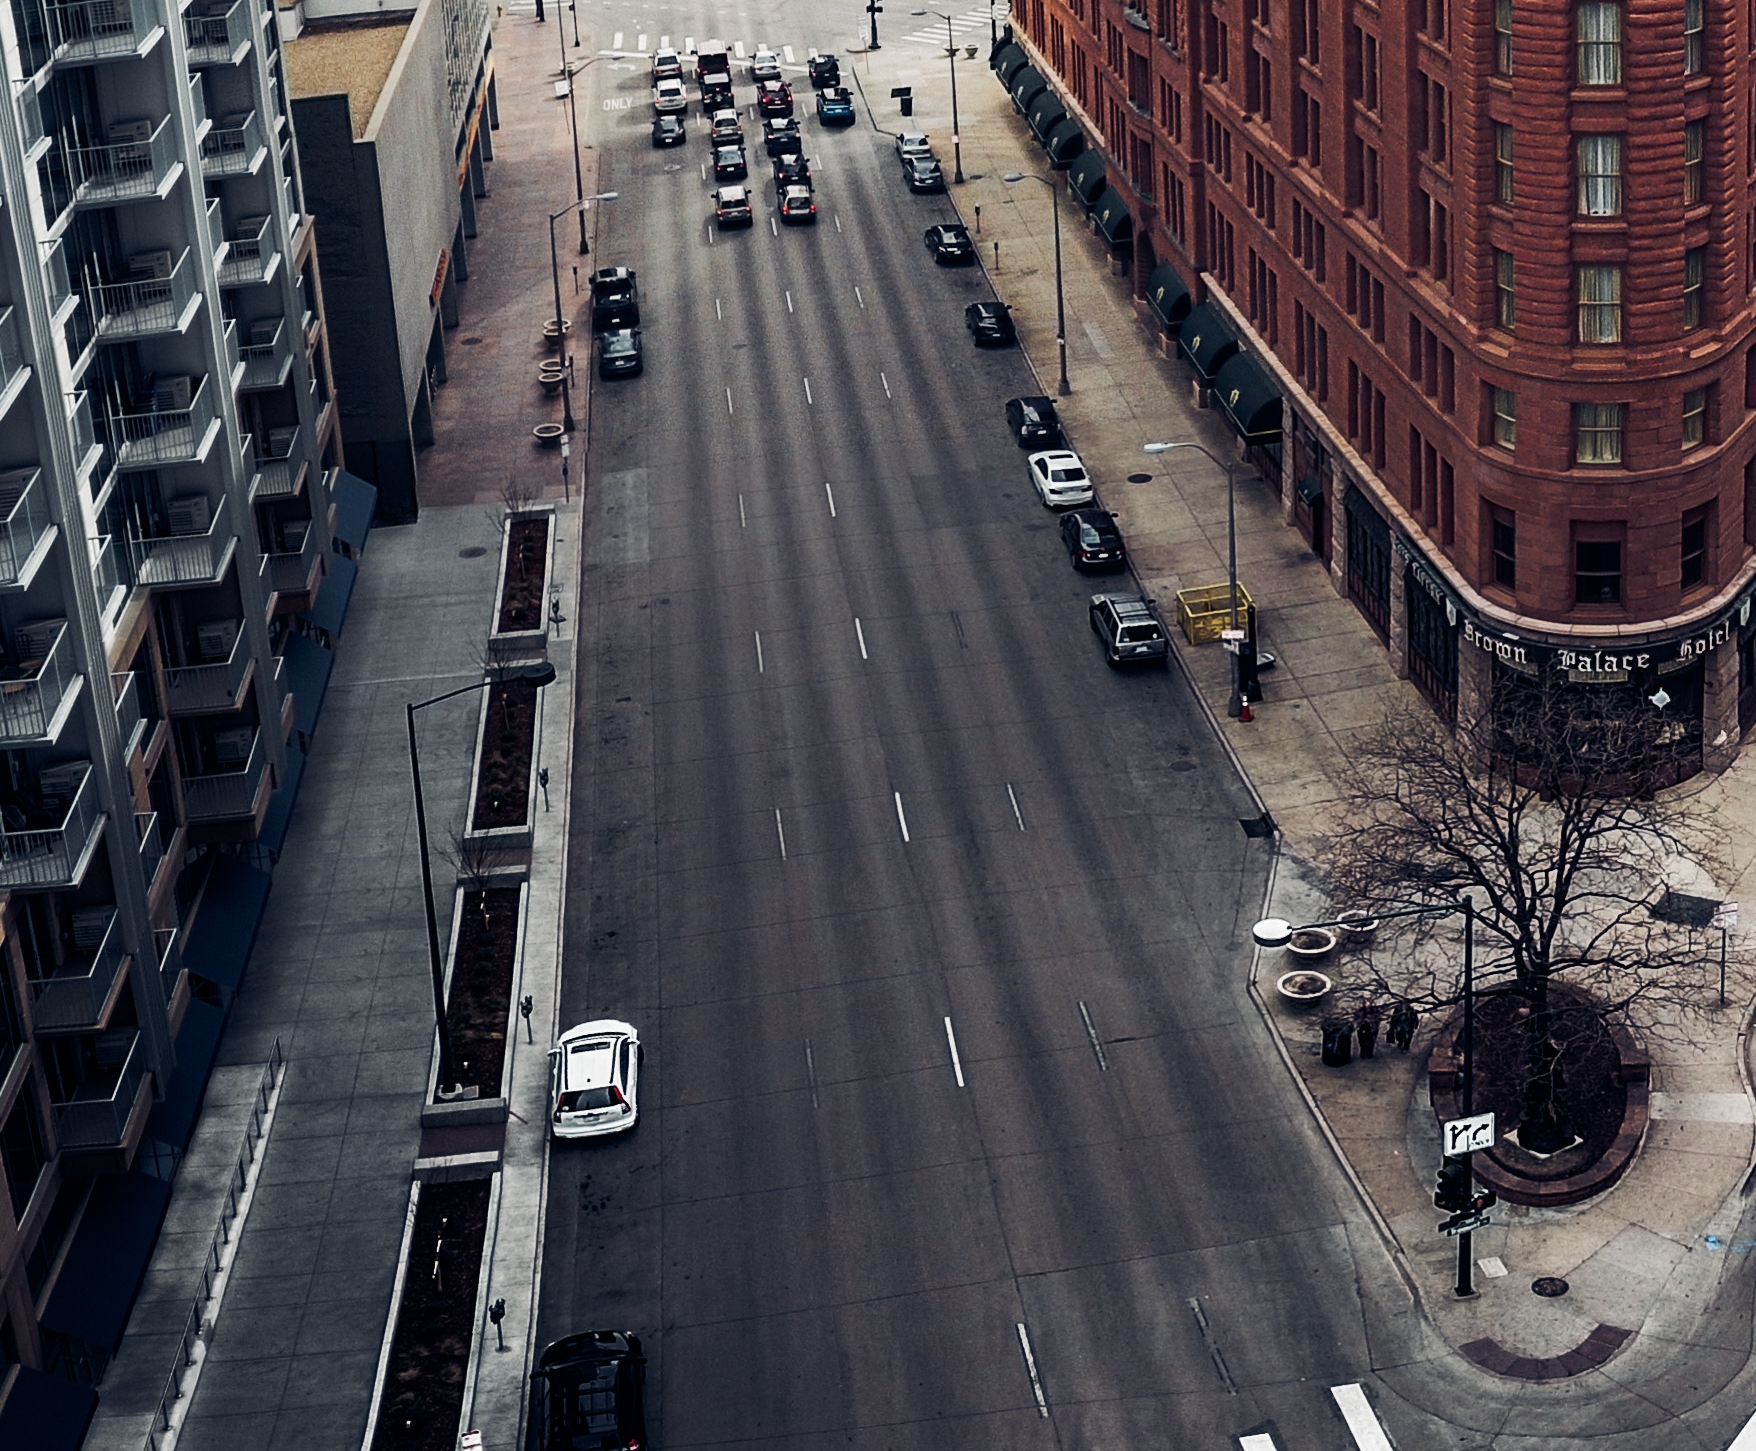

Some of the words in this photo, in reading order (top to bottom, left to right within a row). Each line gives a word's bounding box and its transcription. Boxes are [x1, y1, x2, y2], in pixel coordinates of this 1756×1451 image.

[602, 97, 633, 111] ONLY
[1463, 619, 1527, 664] Brown
[1556, 649, 1650, 673] Palace
[1676, 620, 1730, 661] Hotel
